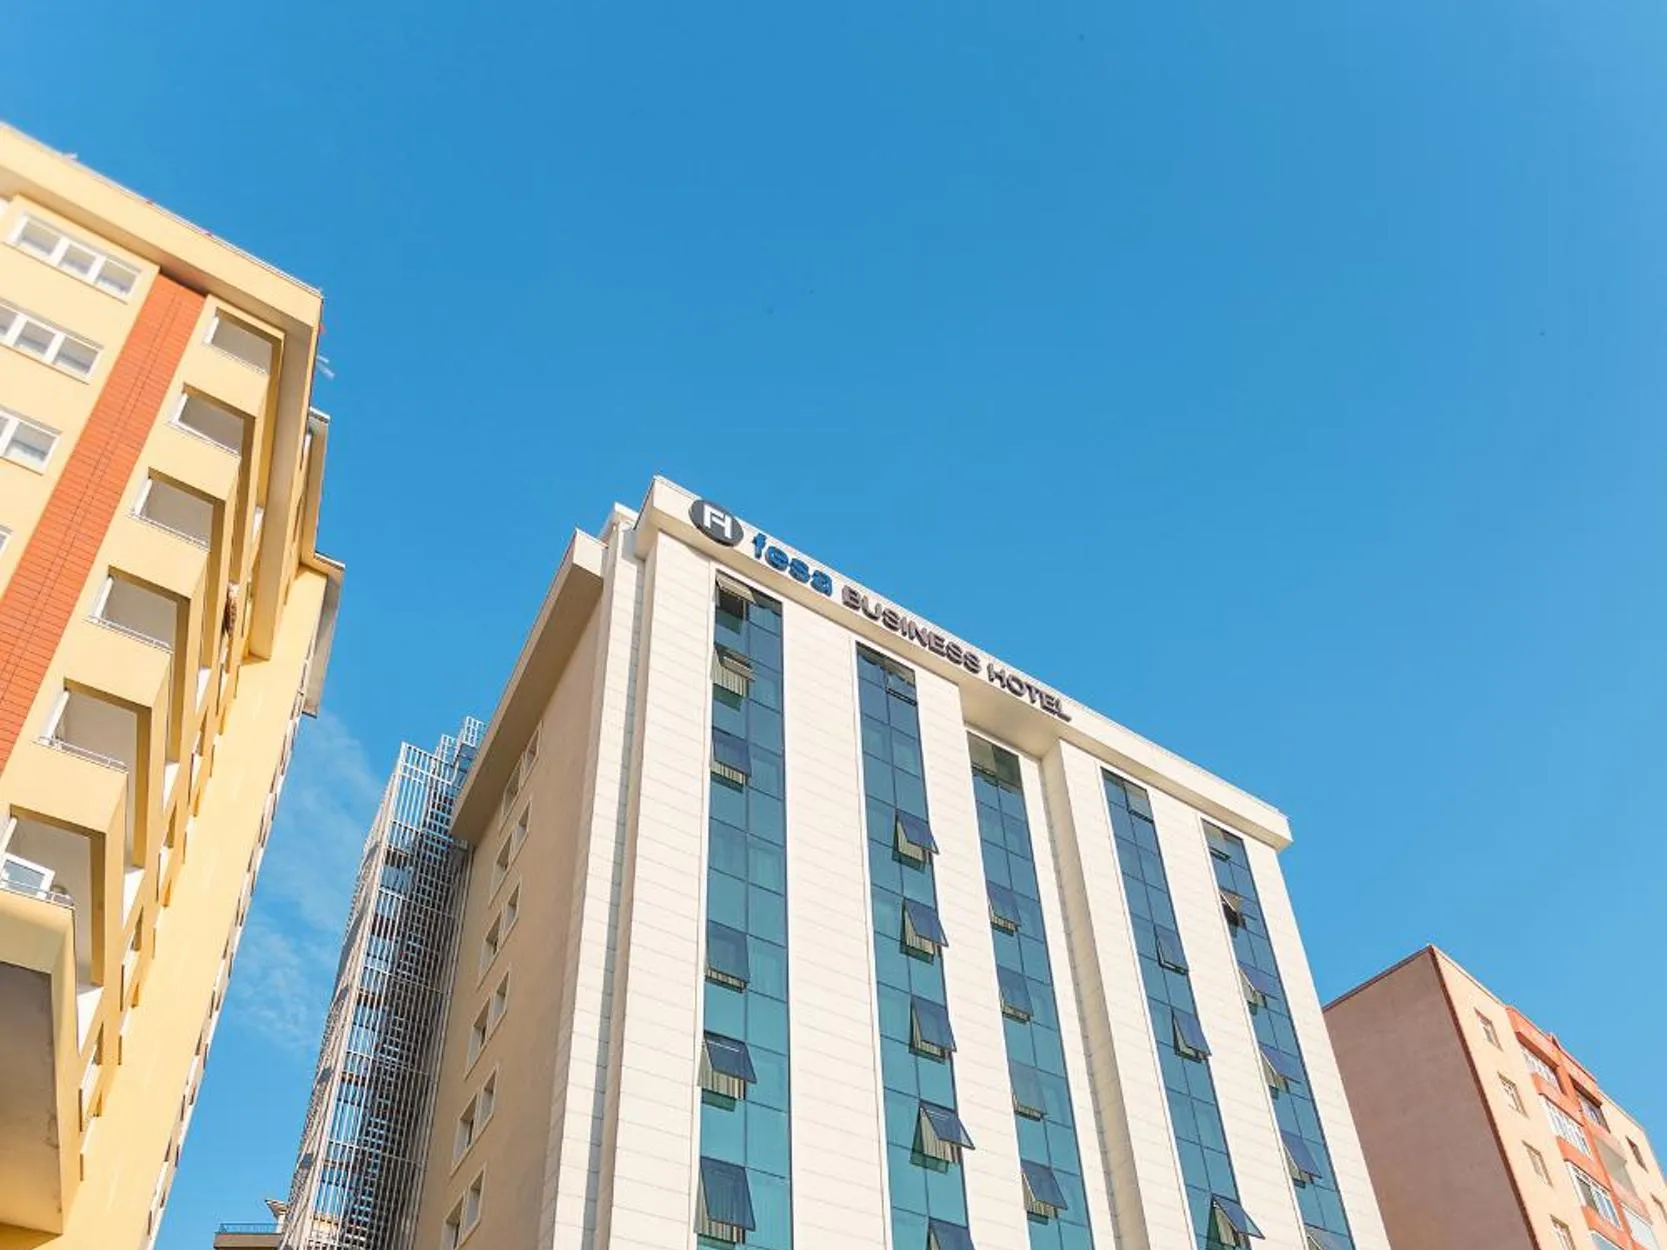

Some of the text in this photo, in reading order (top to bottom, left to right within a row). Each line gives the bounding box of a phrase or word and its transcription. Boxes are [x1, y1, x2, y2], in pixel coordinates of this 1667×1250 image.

[752, 532, 833, 597] fesa
[842, 585, 982, 674] BUSINESS
[987, 662, 1072, 722] HOTEL
